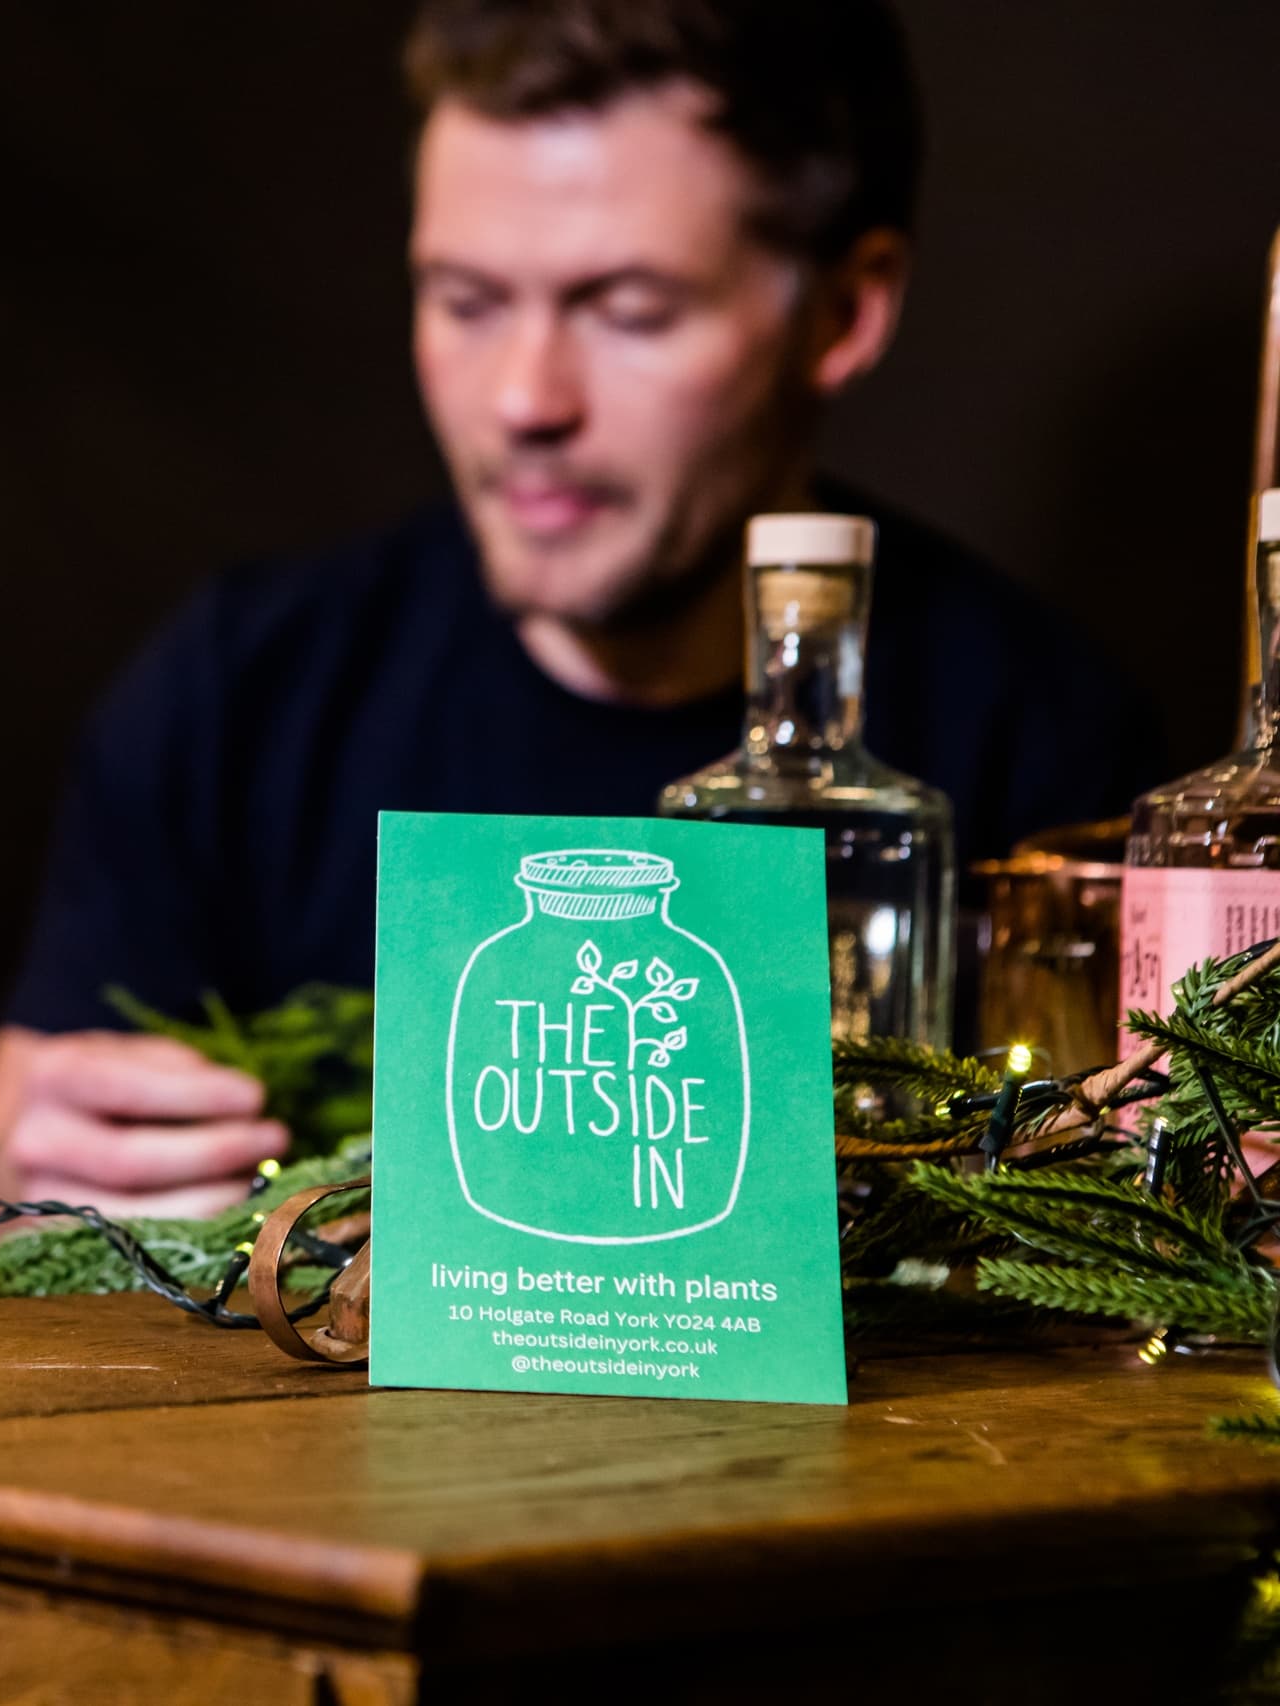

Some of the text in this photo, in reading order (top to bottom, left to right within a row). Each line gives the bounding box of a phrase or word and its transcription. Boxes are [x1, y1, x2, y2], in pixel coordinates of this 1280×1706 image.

[495, 1000, 615, 1067] THE
[474, 1065, 709, 1143] OUTSIDE
[632, 1144, 684, 1209] IN
[431, 1263, 778, 1303] living better with plants
[448, 1305, 761, 1333] 10 Holgate Road York YO24 4AB
[492, 1330, 718, 1355] theoutsideinyork.co.uk
[511, 1355, 700, 1379] @theoutsideinyork
